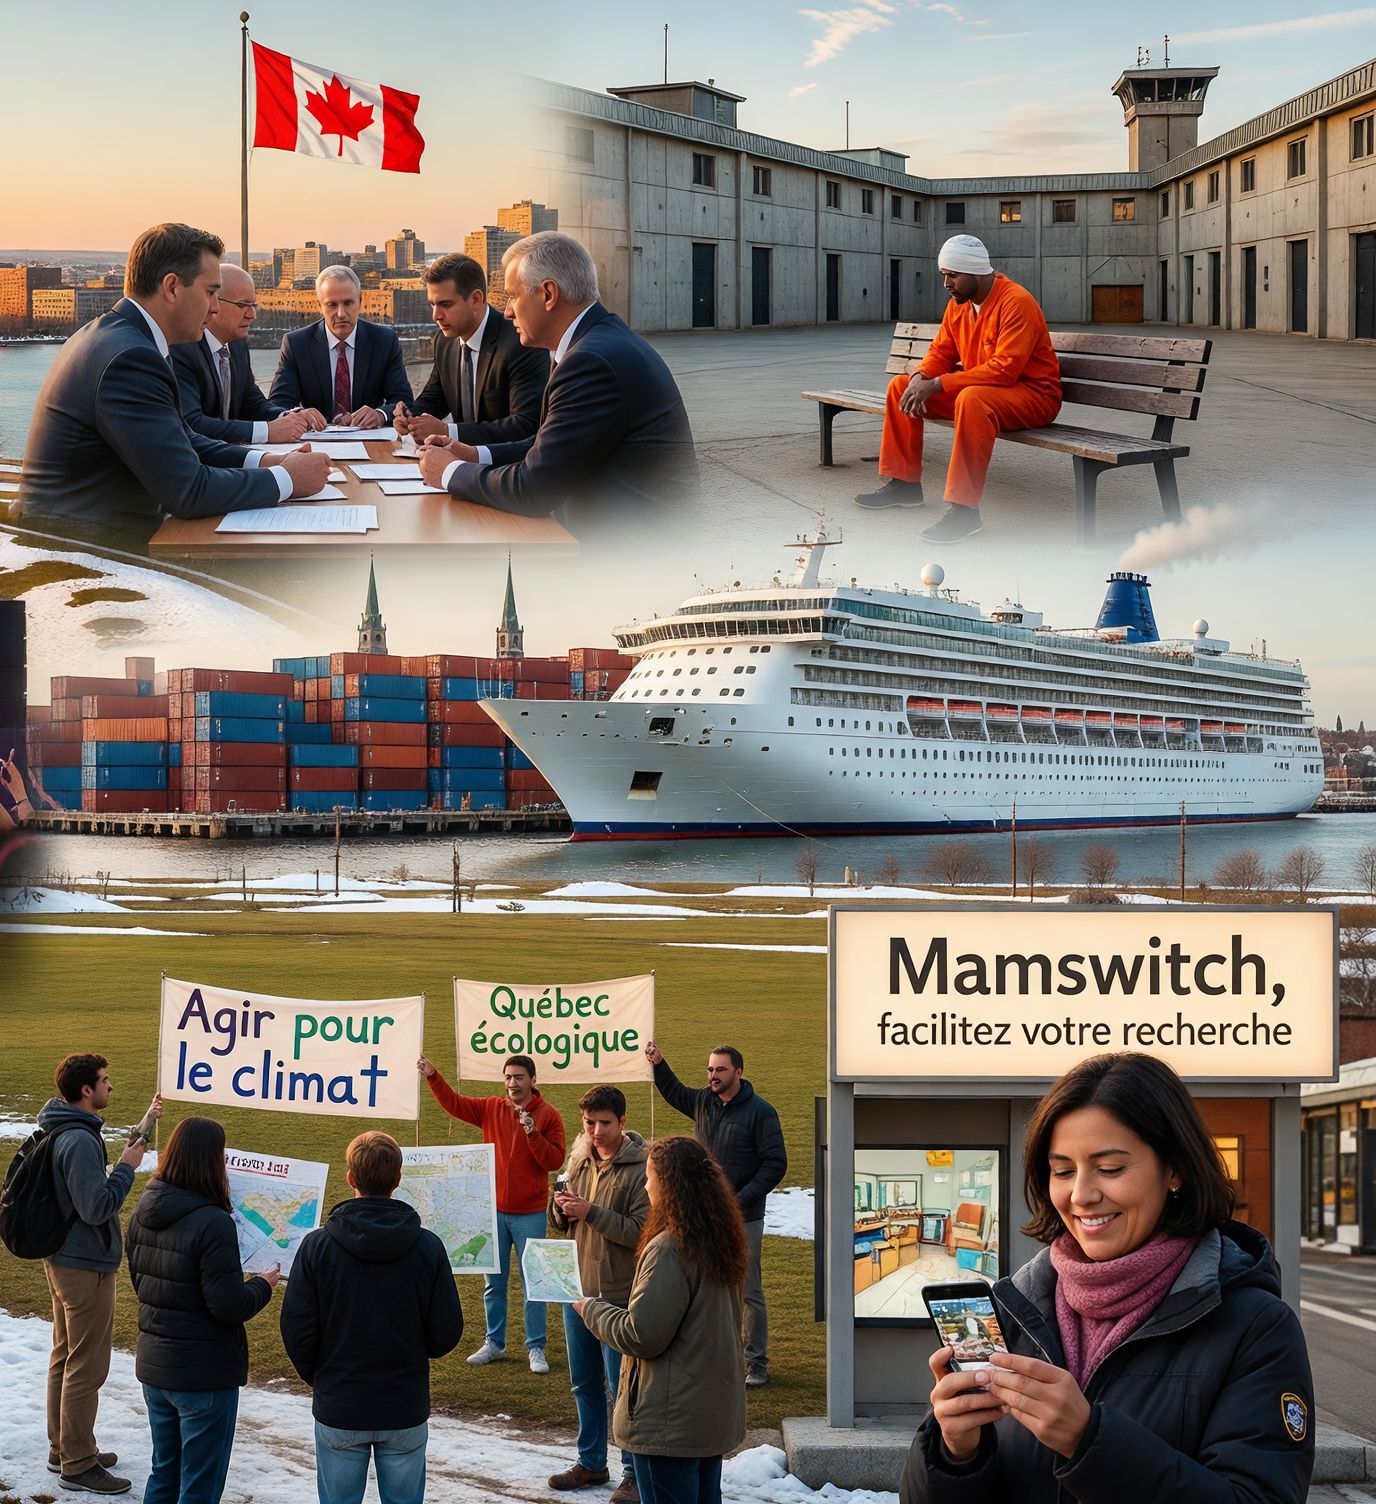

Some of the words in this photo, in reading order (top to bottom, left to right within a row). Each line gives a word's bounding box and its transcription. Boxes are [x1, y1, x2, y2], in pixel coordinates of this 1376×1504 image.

[889, 934, 1285, 1007] Mamswitch,
[177, 988, 275, 1056] Agir
[293, 1014, 394, 1060] pour
[490, 985, 610, 1020] Québec
[877, 1011, 1011, 1046] facilitez
[1021, 1016, 1111, 1046] votre
[1123, 1011, 1292, 1046] recherche
[470, 1020, 639, 1069] écologique
[176, 1041, 213, 1093] le
[232, 1049, 388, 1108] climat
